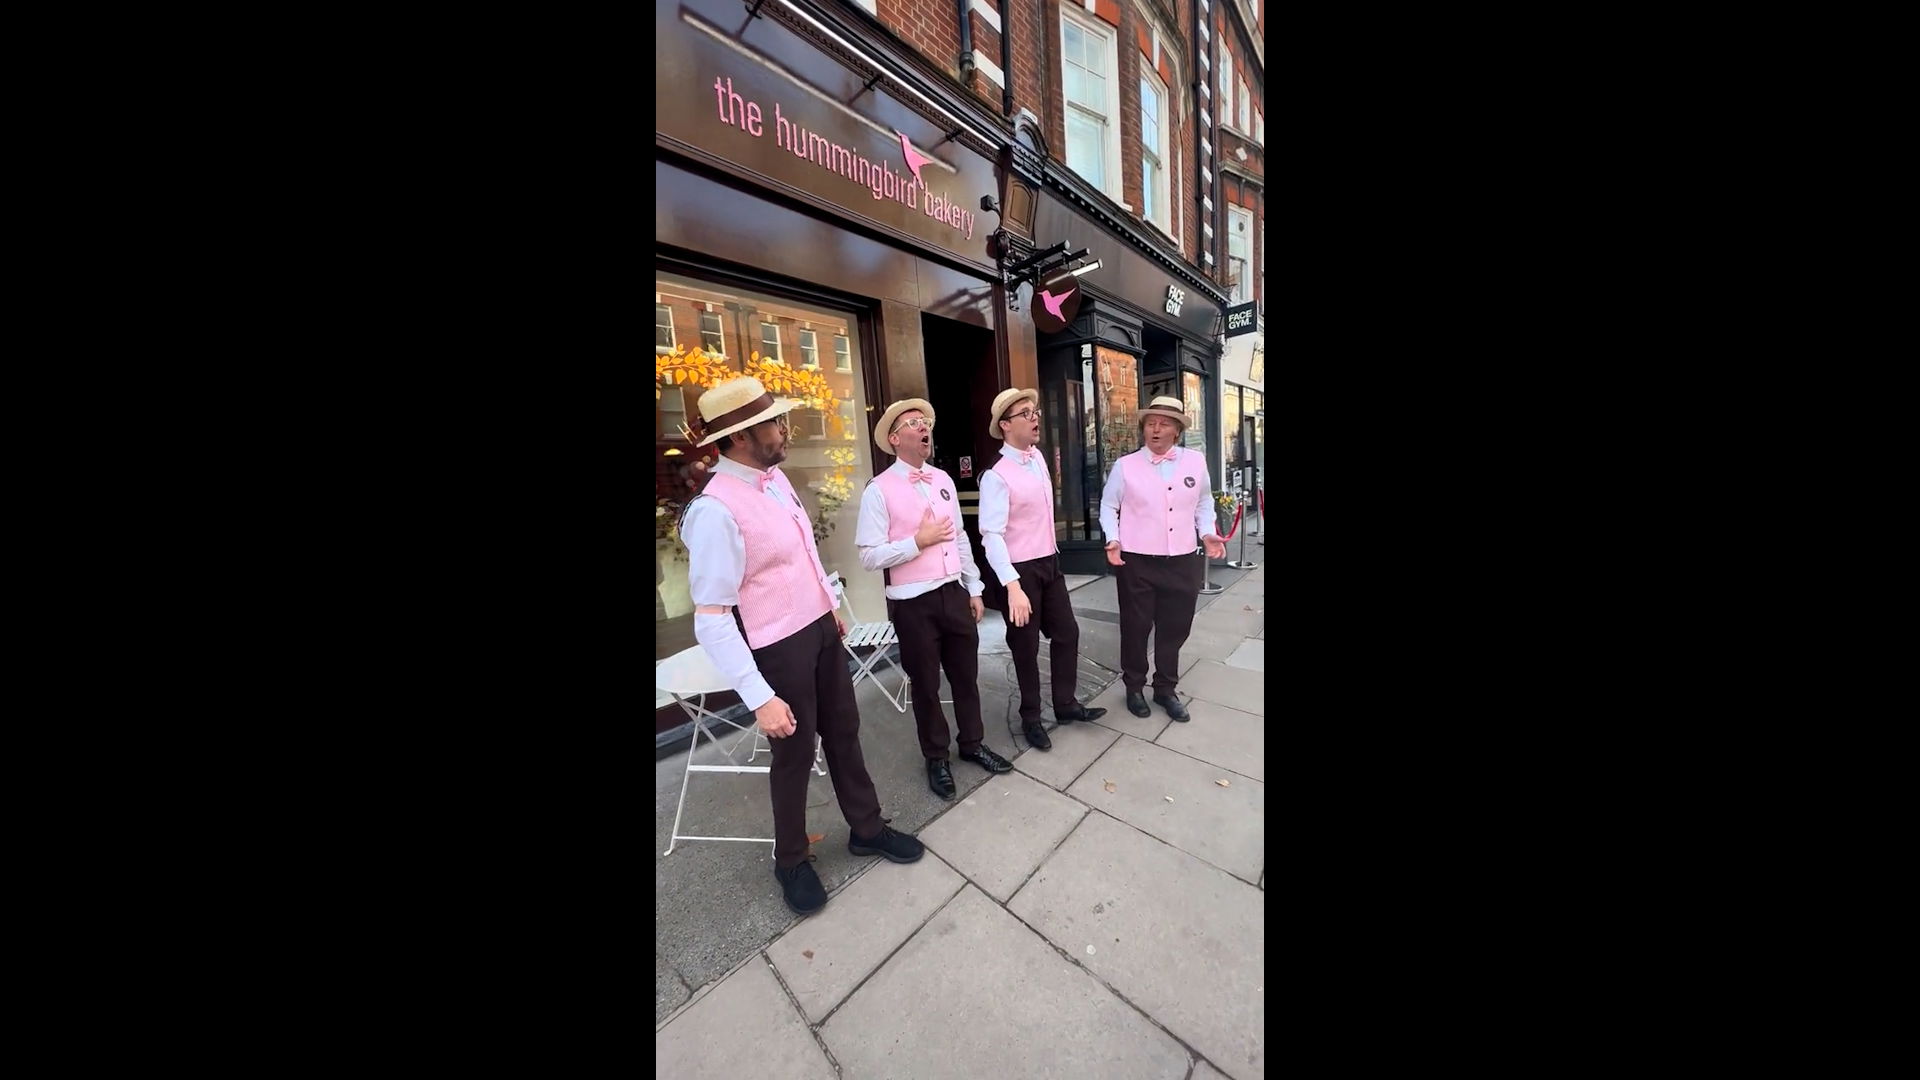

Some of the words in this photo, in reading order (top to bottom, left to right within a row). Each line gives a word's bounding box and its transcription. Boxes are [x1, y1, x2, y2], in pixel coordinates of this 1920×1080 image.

[713, 76, 763, 138] the
[775, 102, 917, 210] hummingbird
[923, 181, 975, 240] bakery
[1168, 284, 1185, 305] FACE
[1228, 309, 1253, 322] FACE
